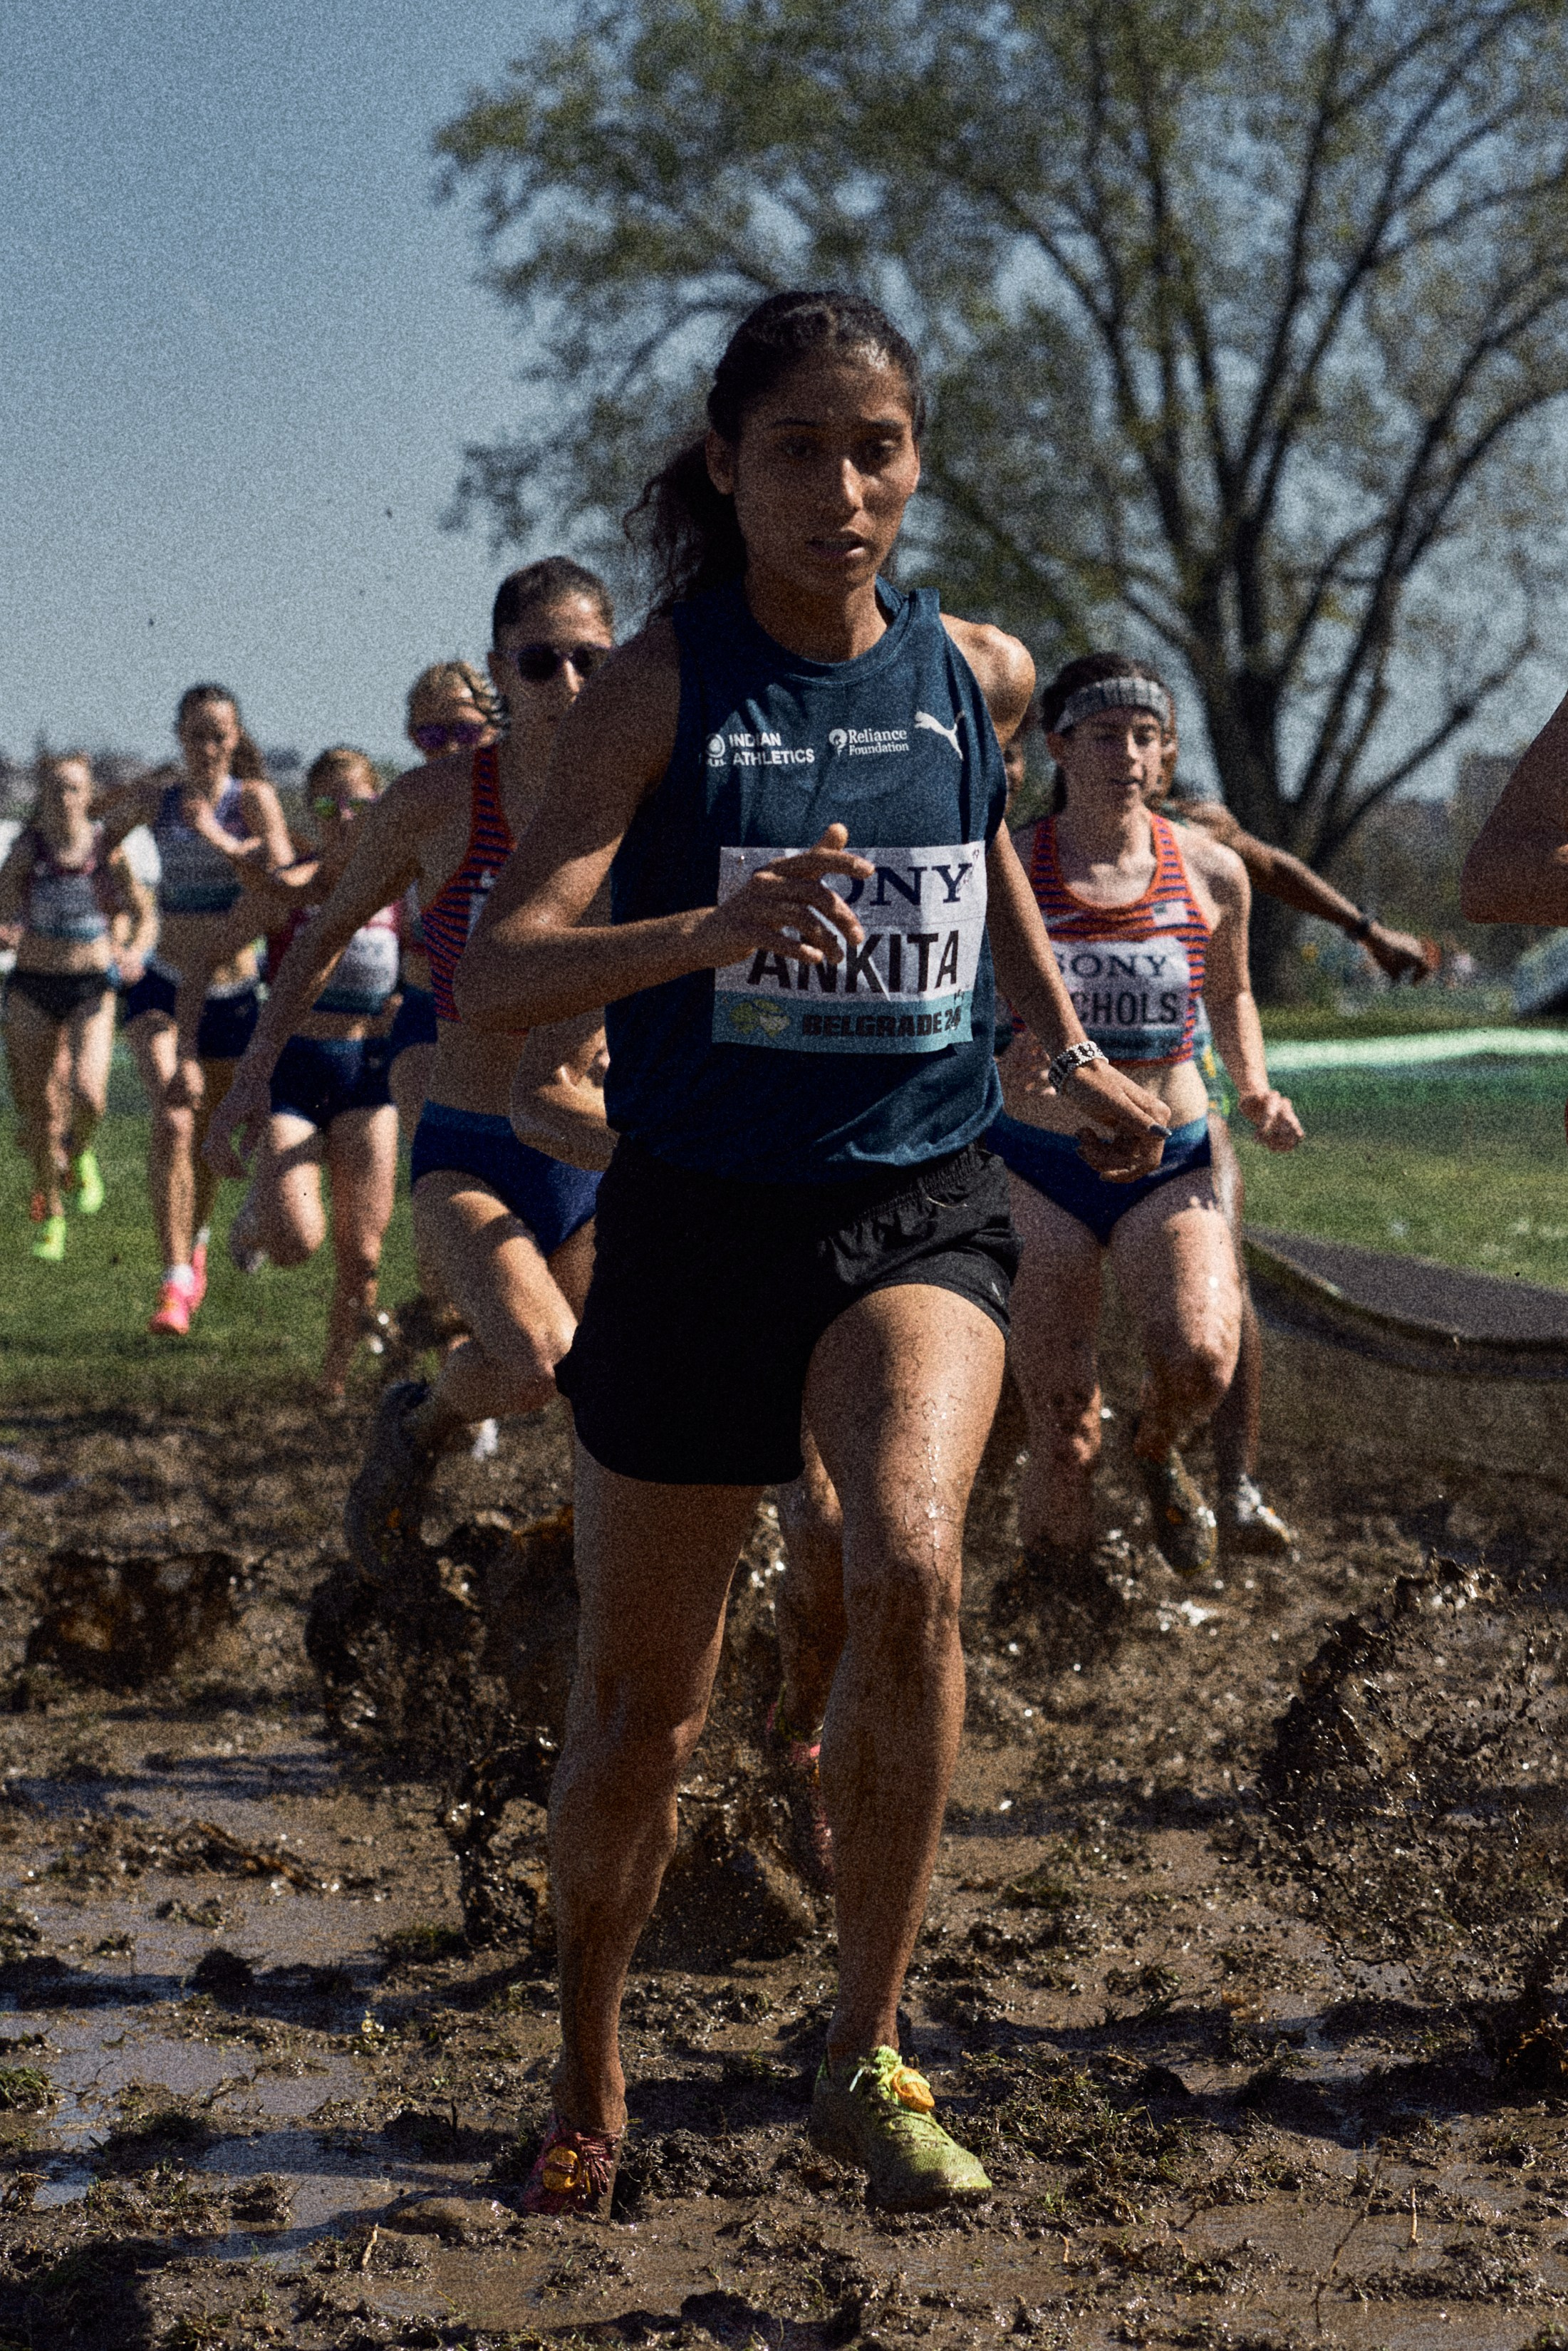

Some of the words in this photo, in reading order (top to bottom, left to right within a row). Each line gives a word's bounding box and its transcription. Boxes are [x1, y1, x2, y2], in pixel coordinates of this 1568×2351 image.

[848, 727, 908, 744] Reliance
[733, 748, 815, 766] ATHLETICS
[849, 742, 910, 756] Foundation
[747, 930, 959, 994] ANKITA
[802, 1011, 942, 1037] BELGRADE
